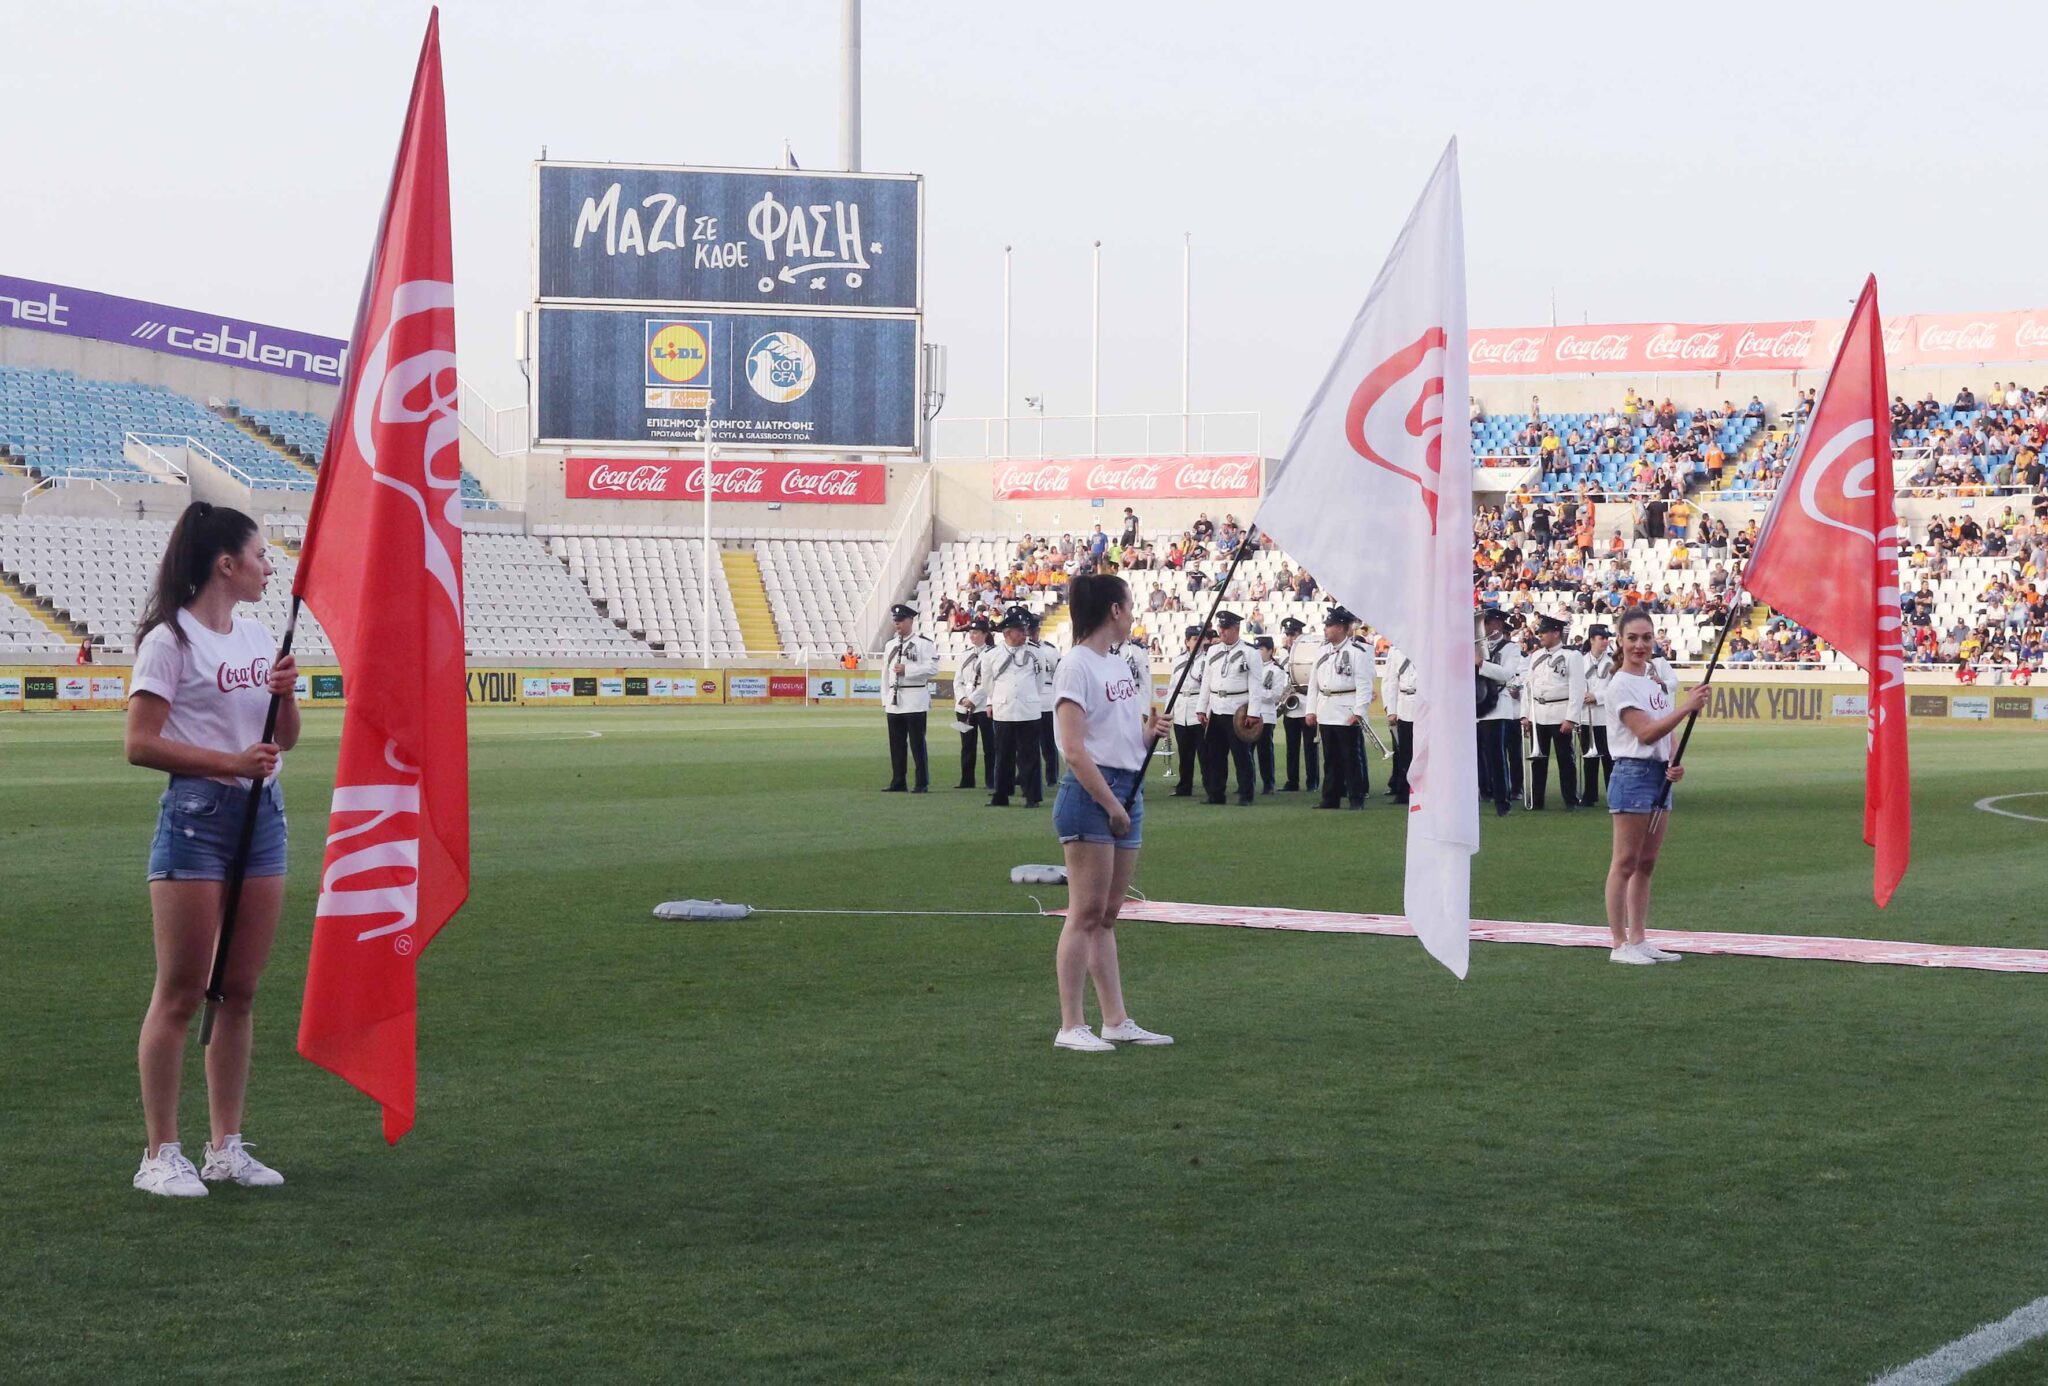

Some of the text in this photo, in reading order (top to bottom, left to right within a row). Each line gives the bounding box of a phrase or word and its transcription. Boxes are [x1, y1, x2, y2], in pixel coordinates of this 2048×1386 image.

[572, 182, 866, 269] ΜΑΖΙ ΣΕ ΚΑΘΕ ΦΑΣΗ
[1555, 335, 1632, 360] Coca-Cola
[1646, 332, 1723, 359] Coca-Cola
[1736, 331, 1812, 358] Coca-Cola
[1919, 323, 1999, 351] Coca-Cola
[1468, 338, 1544, 364] Coca-Cola
[771, 371, 798, 383] CFA
[646, 418, 700, 428] ΕΠΙΣΗΜΟΣ
[754, 420, 814, 430] ΔΙΑΤΡΟΦΗΣ
[588, 464, 671, 492] Coca-Cola
[685, 466, 767, 493] Coa-Cola
[781, 468, 862, 496] Coca-Cola
[999, 464, 1071, 492] Coca-Cola
[1087, 463, 1159, 490] Coca-Cola
[1175, 463, 1250, 489] Coca-Cola
[217, 657, 272, 693] Coca-Co
[477, 672, 516, 702] YOU!
[1767, 688, 1822, 720] YOU!
